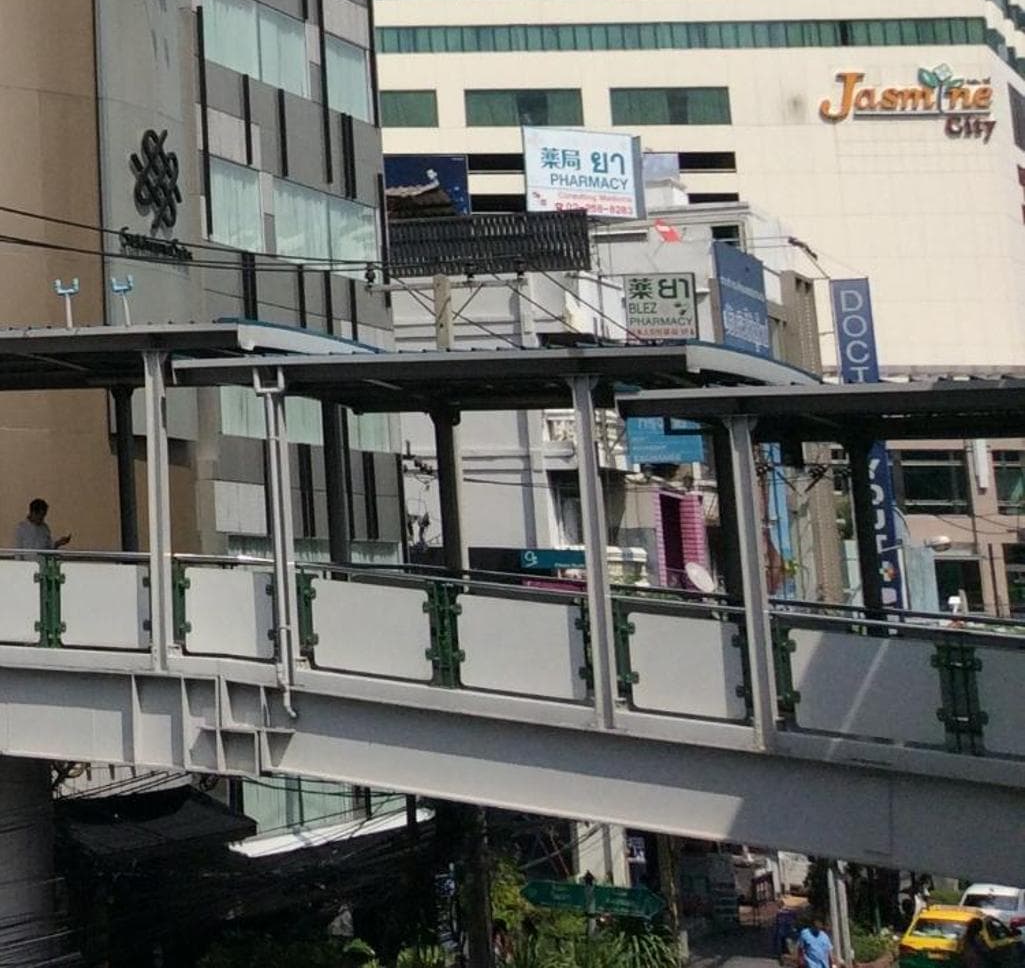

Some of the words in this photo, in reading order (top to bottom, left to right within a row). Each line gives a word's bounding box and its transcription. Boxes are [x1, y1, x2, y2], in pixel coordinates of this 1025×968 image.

[818, 63, 993, 124] Jasmine
[943, 115, 996, 144] City
[591, 151, 625, 175] ยา
[550, 173, 629, 190] PHARMACY
[658, 278, 689, 299] ยา
[628, 302, 657, 314] BLEZ
[629, 317, 693, 326] PHARMACY
[839, 290, 870, 382] DOCT
